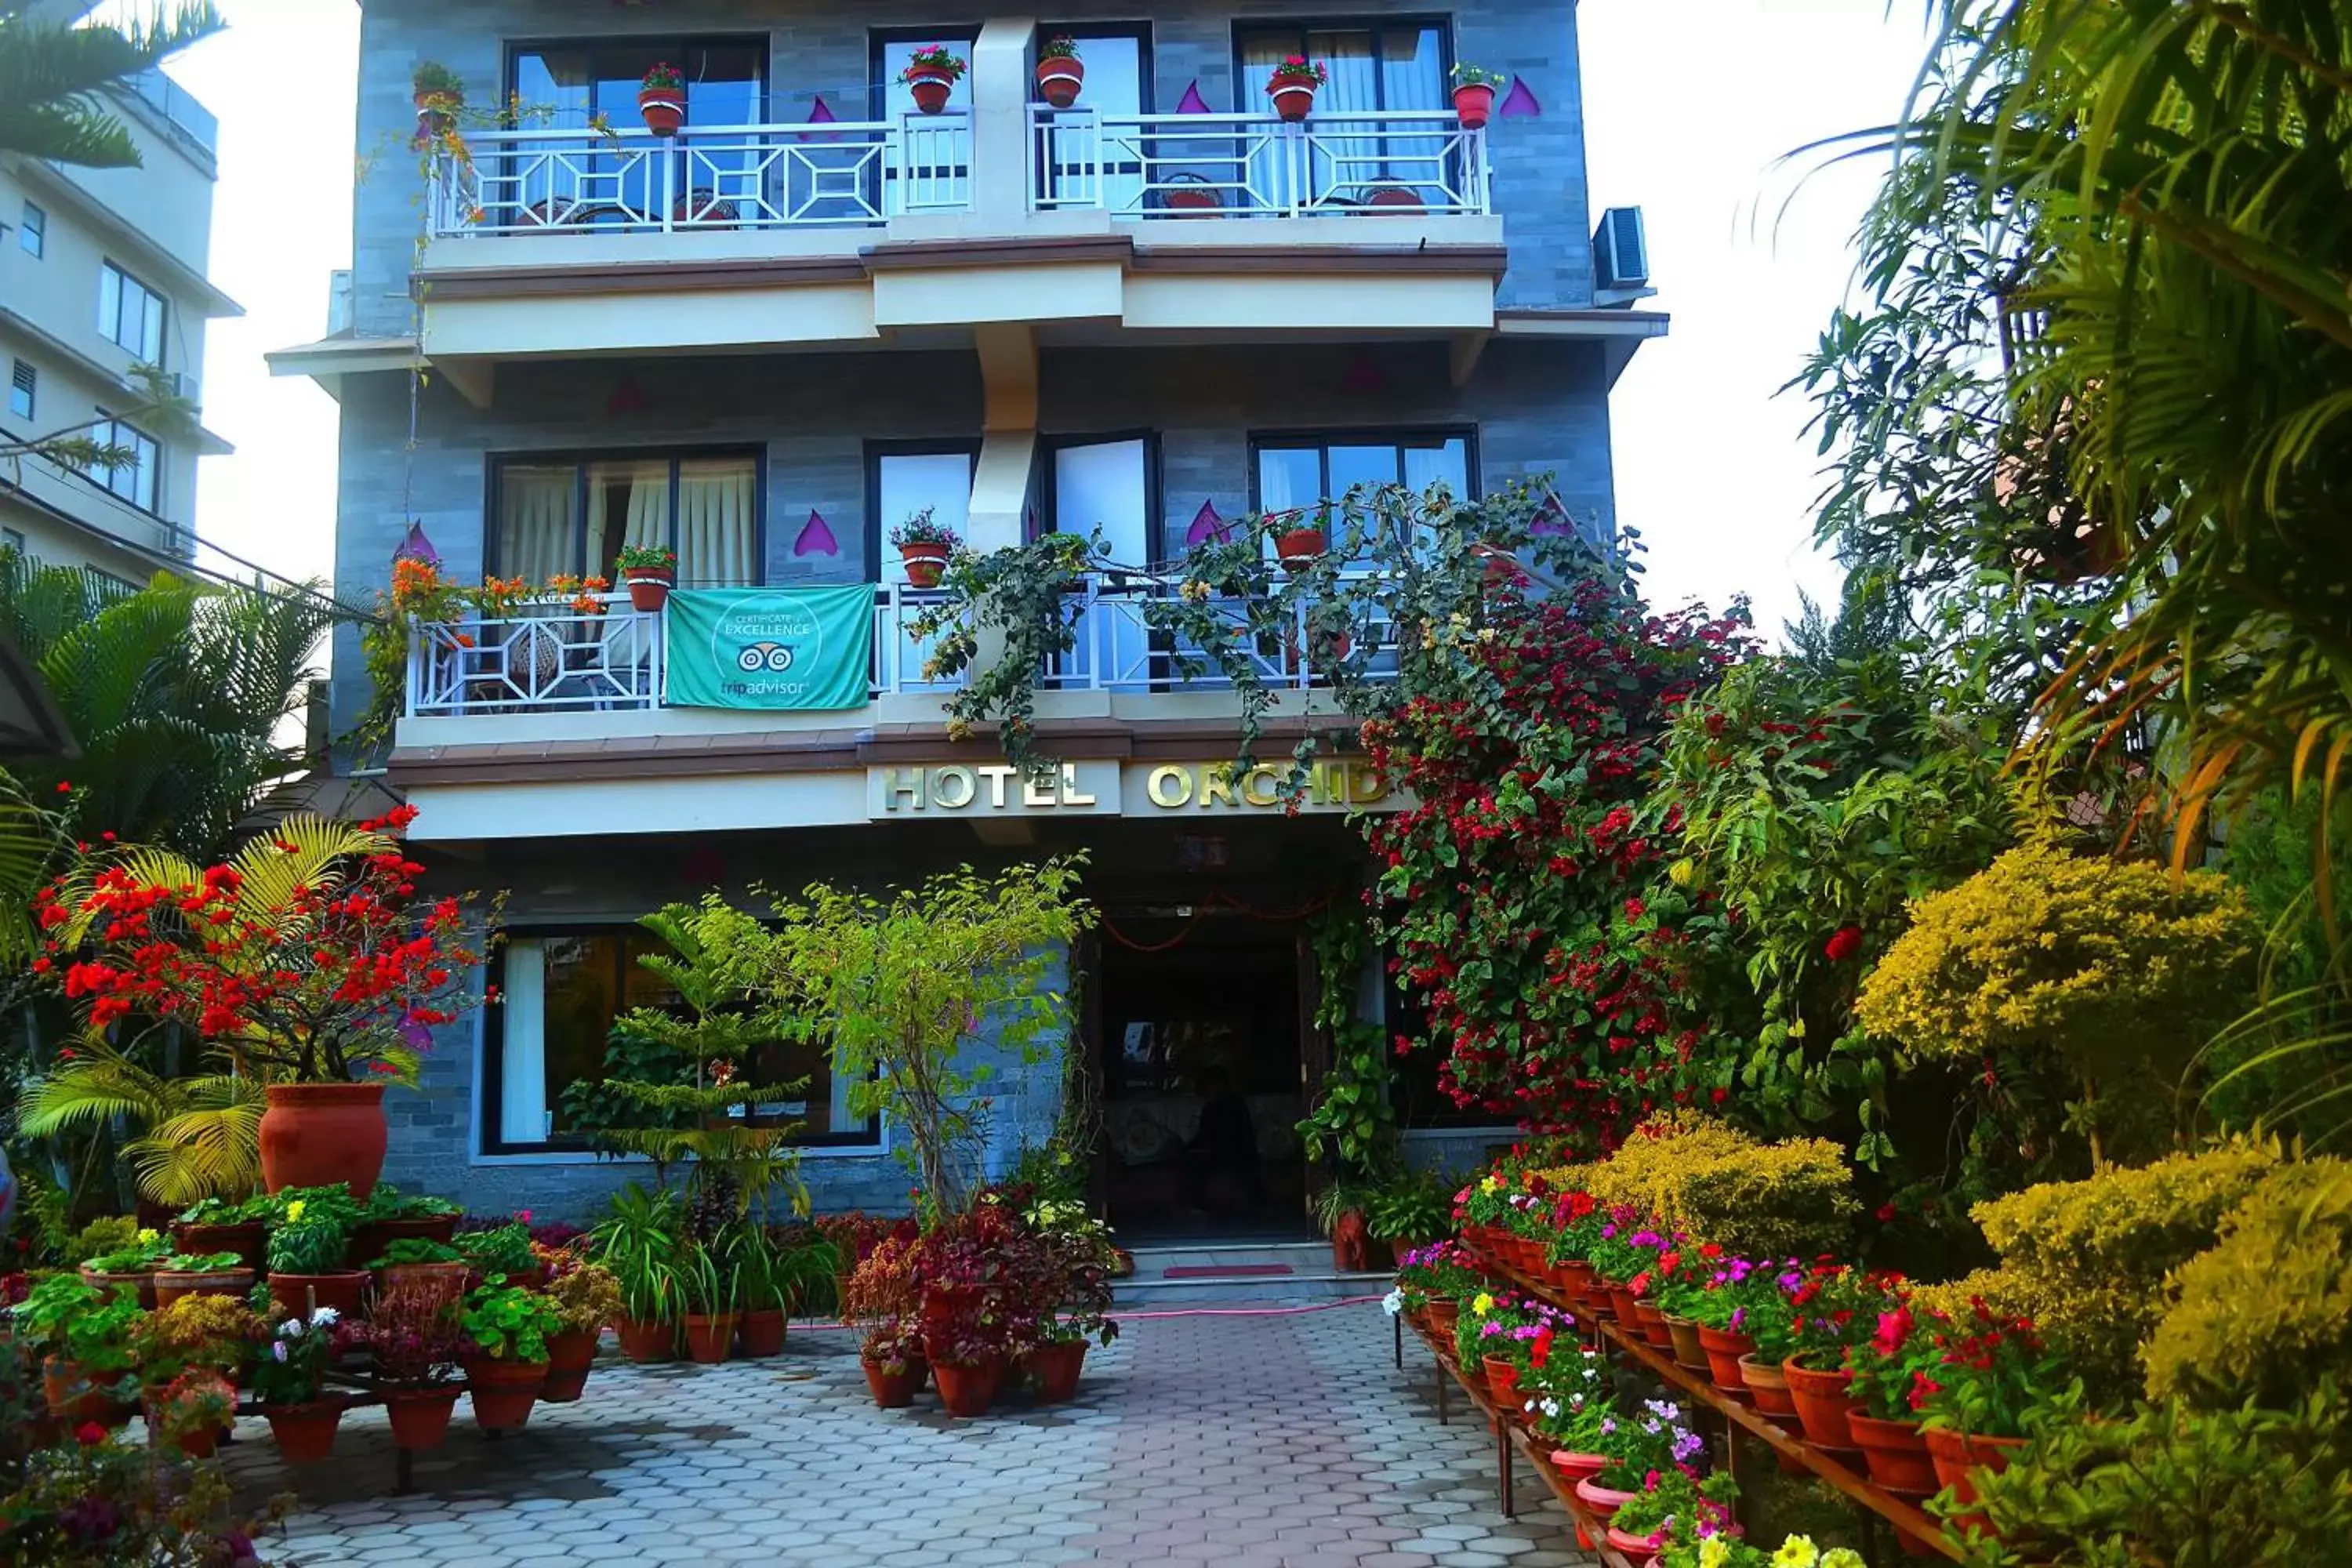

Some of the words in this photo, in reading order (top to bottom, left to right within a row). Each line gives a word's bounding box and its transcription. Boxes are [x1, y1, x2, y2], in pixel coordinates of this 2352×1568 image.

[736, 614, 792, 623] CERTIFICATE
[726, 623, 809, 635] EXCELLENCE
[721, 679, 804, 697] tripadvisor
[886, 764, 1095, 811] HOTEL
